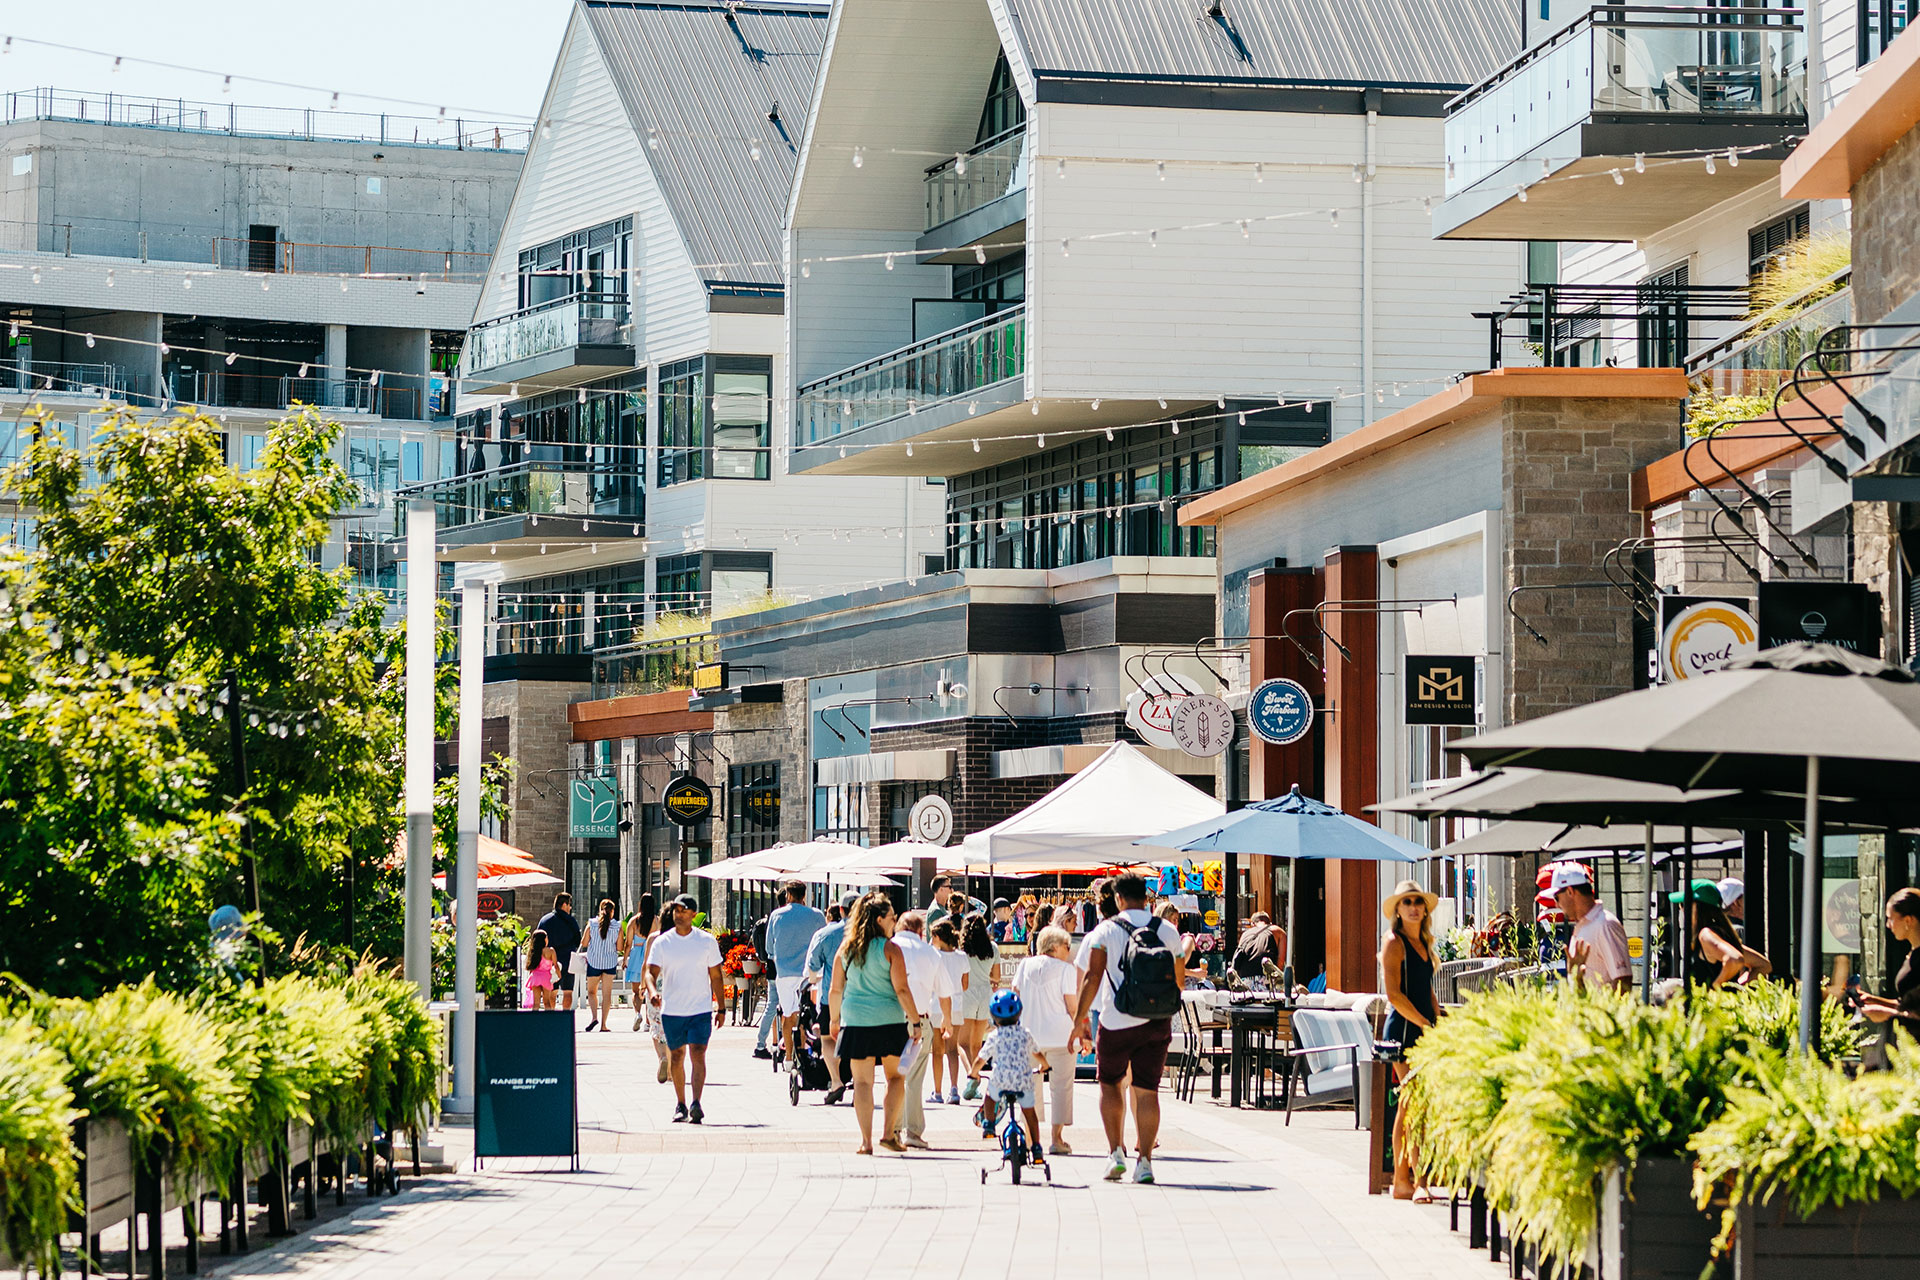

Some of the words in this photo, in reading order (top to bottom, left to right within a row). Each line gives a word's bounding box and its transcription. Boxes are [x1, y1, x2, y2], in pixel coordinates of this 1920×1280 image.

[1263, 691, 1297, 705] Sweet
[1261, 704, 1300, 716] Harbour
[668, 796, 709, 807] PAWVENGERS
[573, 824, 616, 833] ESSENCE
[490, 1077, 524, 1085] RANGE
[525, 1077, 558, 1085] ROVER
